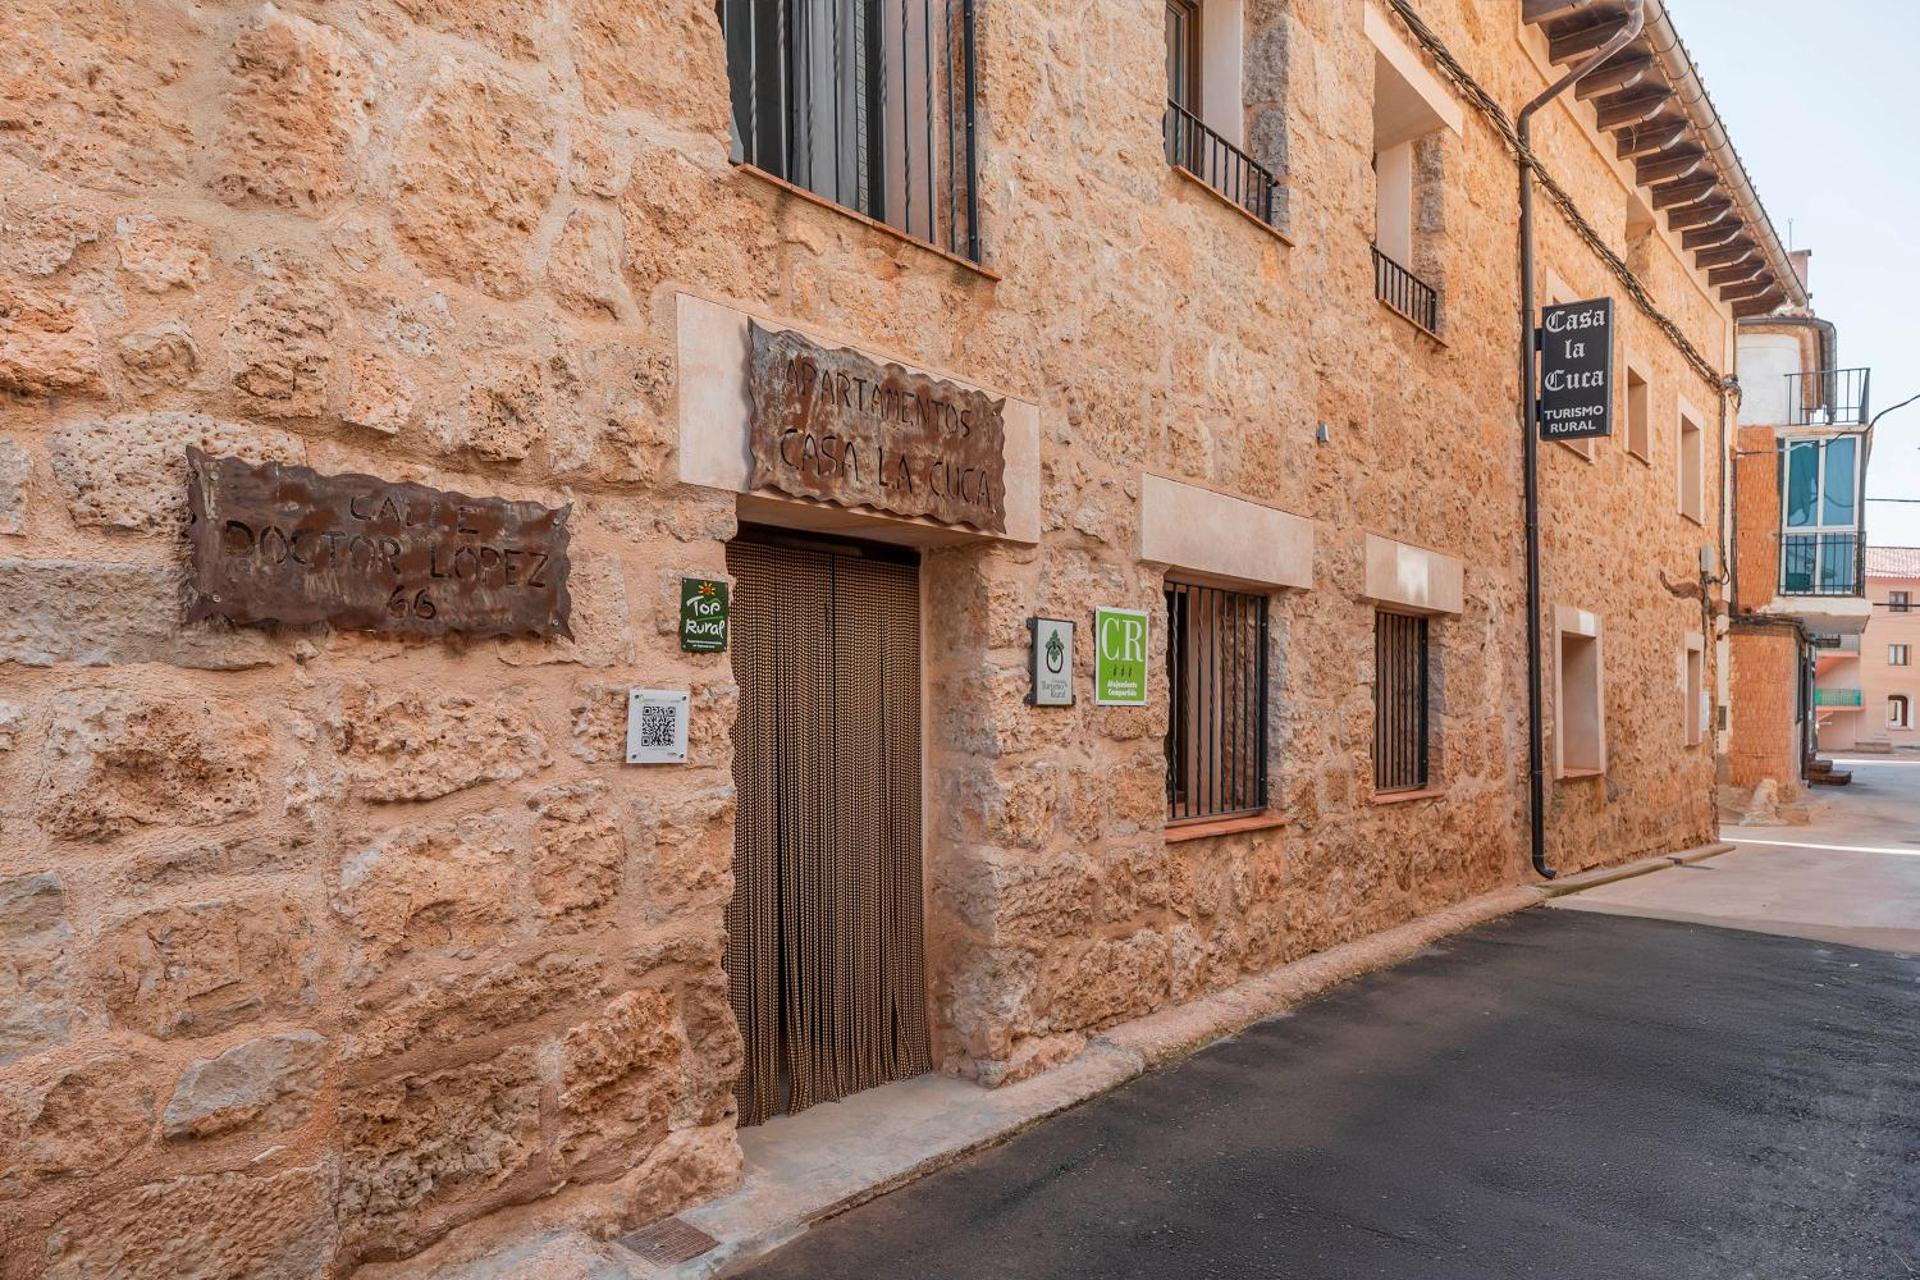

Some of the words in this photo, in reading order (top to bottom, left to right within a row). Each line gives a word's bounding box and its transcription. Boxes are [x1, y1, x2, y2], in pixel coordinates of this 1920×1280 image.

[1546, 309, 1605, 333] Casa
[1564, 340, 1586, 359] la
[1544, 369, 1604, 392] Cuca
[786, 360, 971, 437] APARTAMENTOS
[1544, 405, 1604, 420] TURISMO
[1550, 420, 1597, 434] RURAL
[780, 428, 859, 482] CASA
[878, 447, 913, 494] LA
[928, 461, 992, 508] CUCA
[349, 496, 479, 535] CALLE
[225, 520, 402, 575] DOCTOR
[431, 546, 549, 588] LOPEZ
[387, 585, 438, 620] 66
[685, 619, 725, 639] Rural
[1101, 617, 1144, 662] CR
